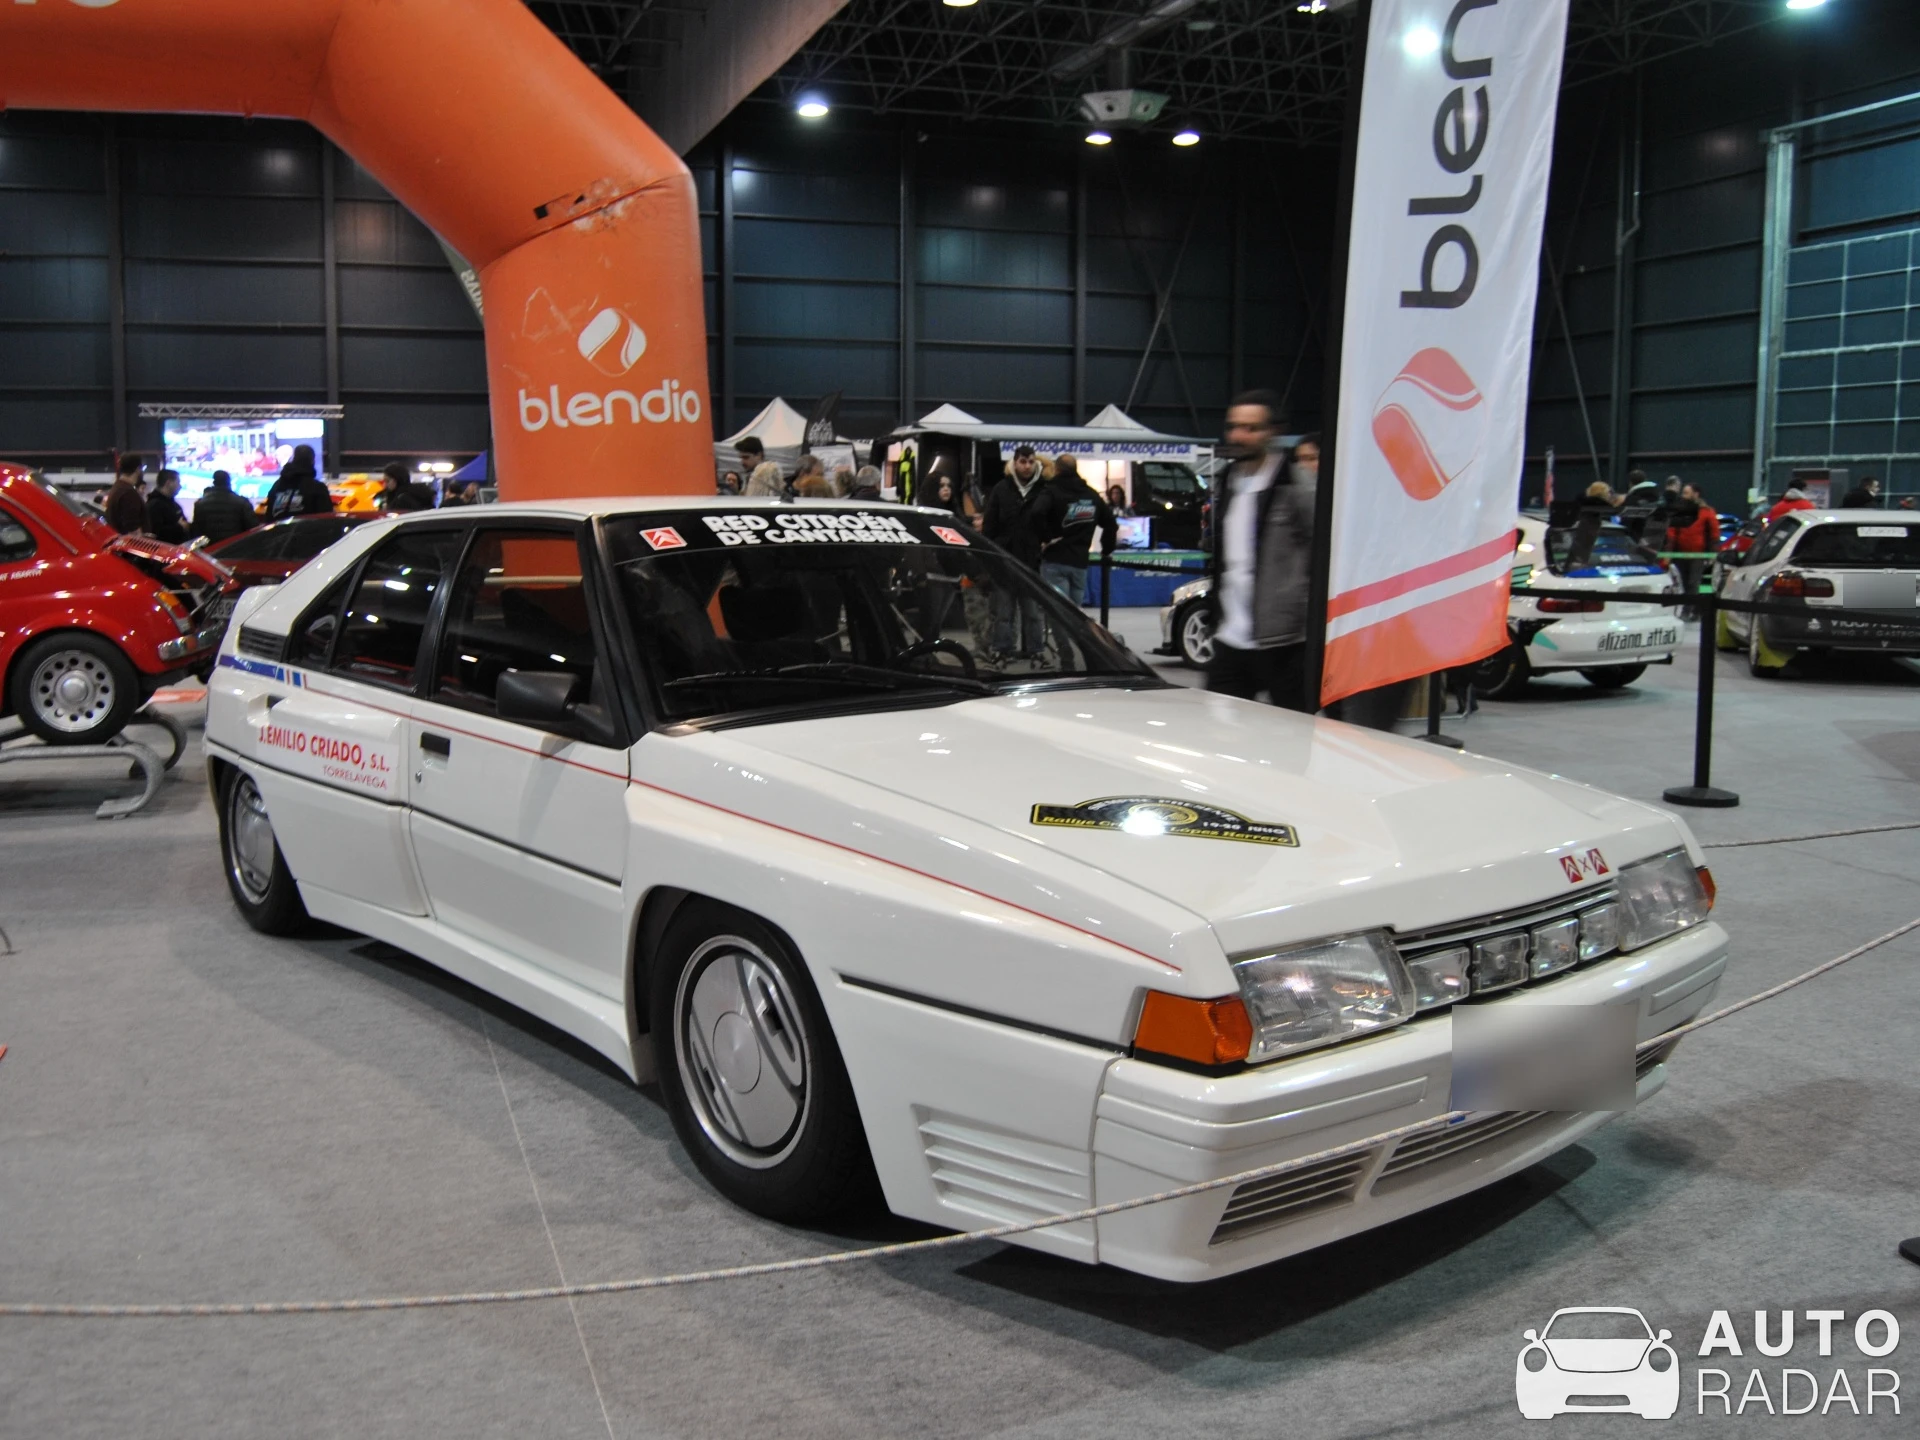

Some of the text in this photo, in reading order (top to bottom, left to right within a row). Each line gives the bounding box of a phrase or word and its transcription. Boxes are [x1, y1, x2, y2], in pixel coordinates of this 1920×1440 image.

[518, 378, 701, 432] blendio
[702, 512, 907, 532] RED CITROËN
[716, 529, 921, 546] DE CANTABRIA
[259, 725, 390, 772] J.EMILIO CRIADO, S.L.
[323, 764, 388, 790] TORRELAVEGA
[1043, 816, 1095, 826] Rallye
[1222, 831, 1289, 843] Herrero
